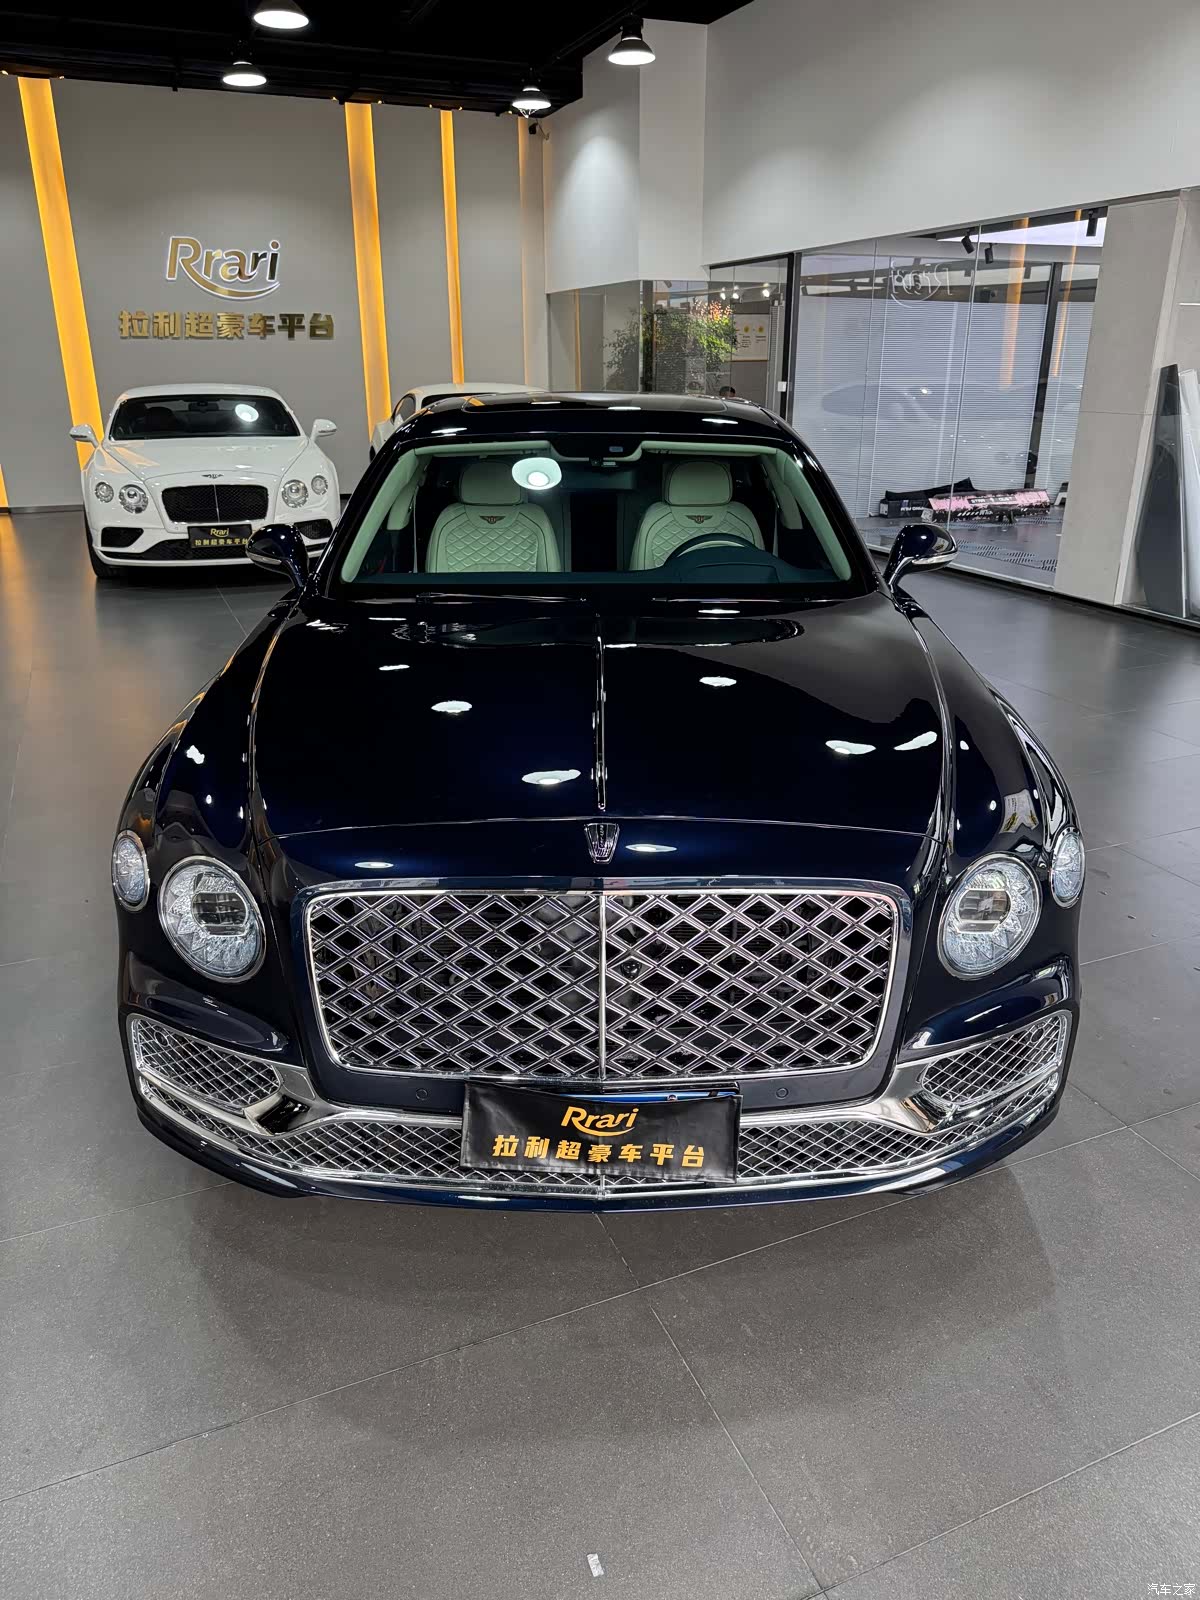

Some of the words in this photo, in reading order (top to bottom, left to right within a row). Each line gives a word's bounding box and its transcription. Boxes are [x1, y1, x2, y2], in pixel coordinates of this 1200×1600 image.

[166, 236, 281, 300] Rrari
[118, 310, 335, 340] 拉利超豪车平台
[210, 528, 229, 537] Rrari
[560, 1106, 639, 1137] Rrari
[492, 1134, 705, 1168] 拉利超豪车平台
